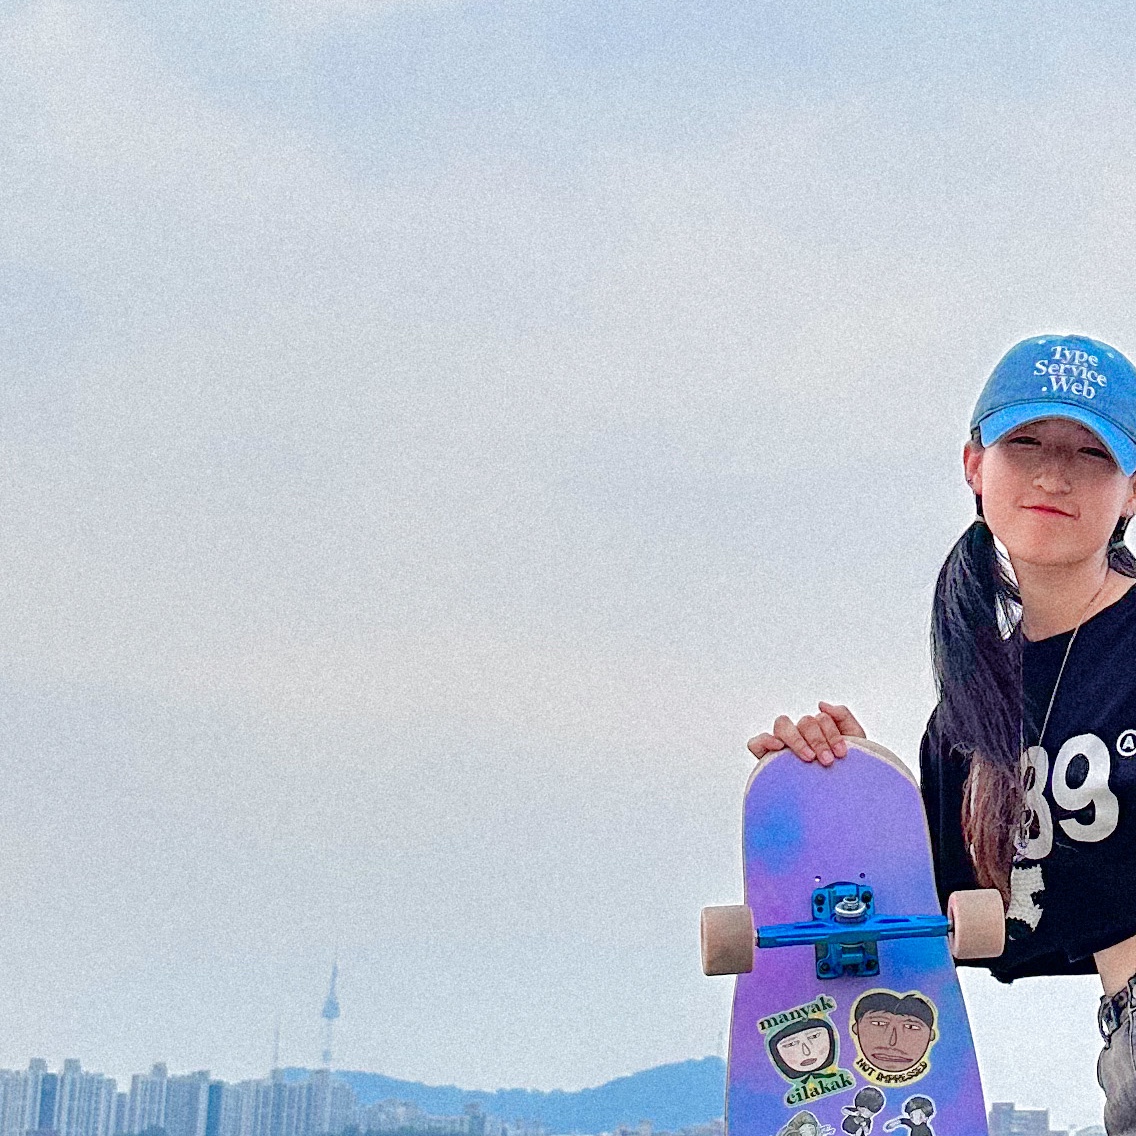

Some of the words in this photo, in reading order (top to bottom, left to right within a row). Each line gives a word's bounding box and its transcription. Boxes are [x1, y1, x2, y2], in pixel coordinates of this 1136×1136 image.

[1051, 346, 1099, 367] Type
[1033, 359, 1107, 387] Service
[1041, 375, 1096, 399] .Web
[758, 996, 835, 1031] manyak
[785, 1075, 854, 1105] cilakak
